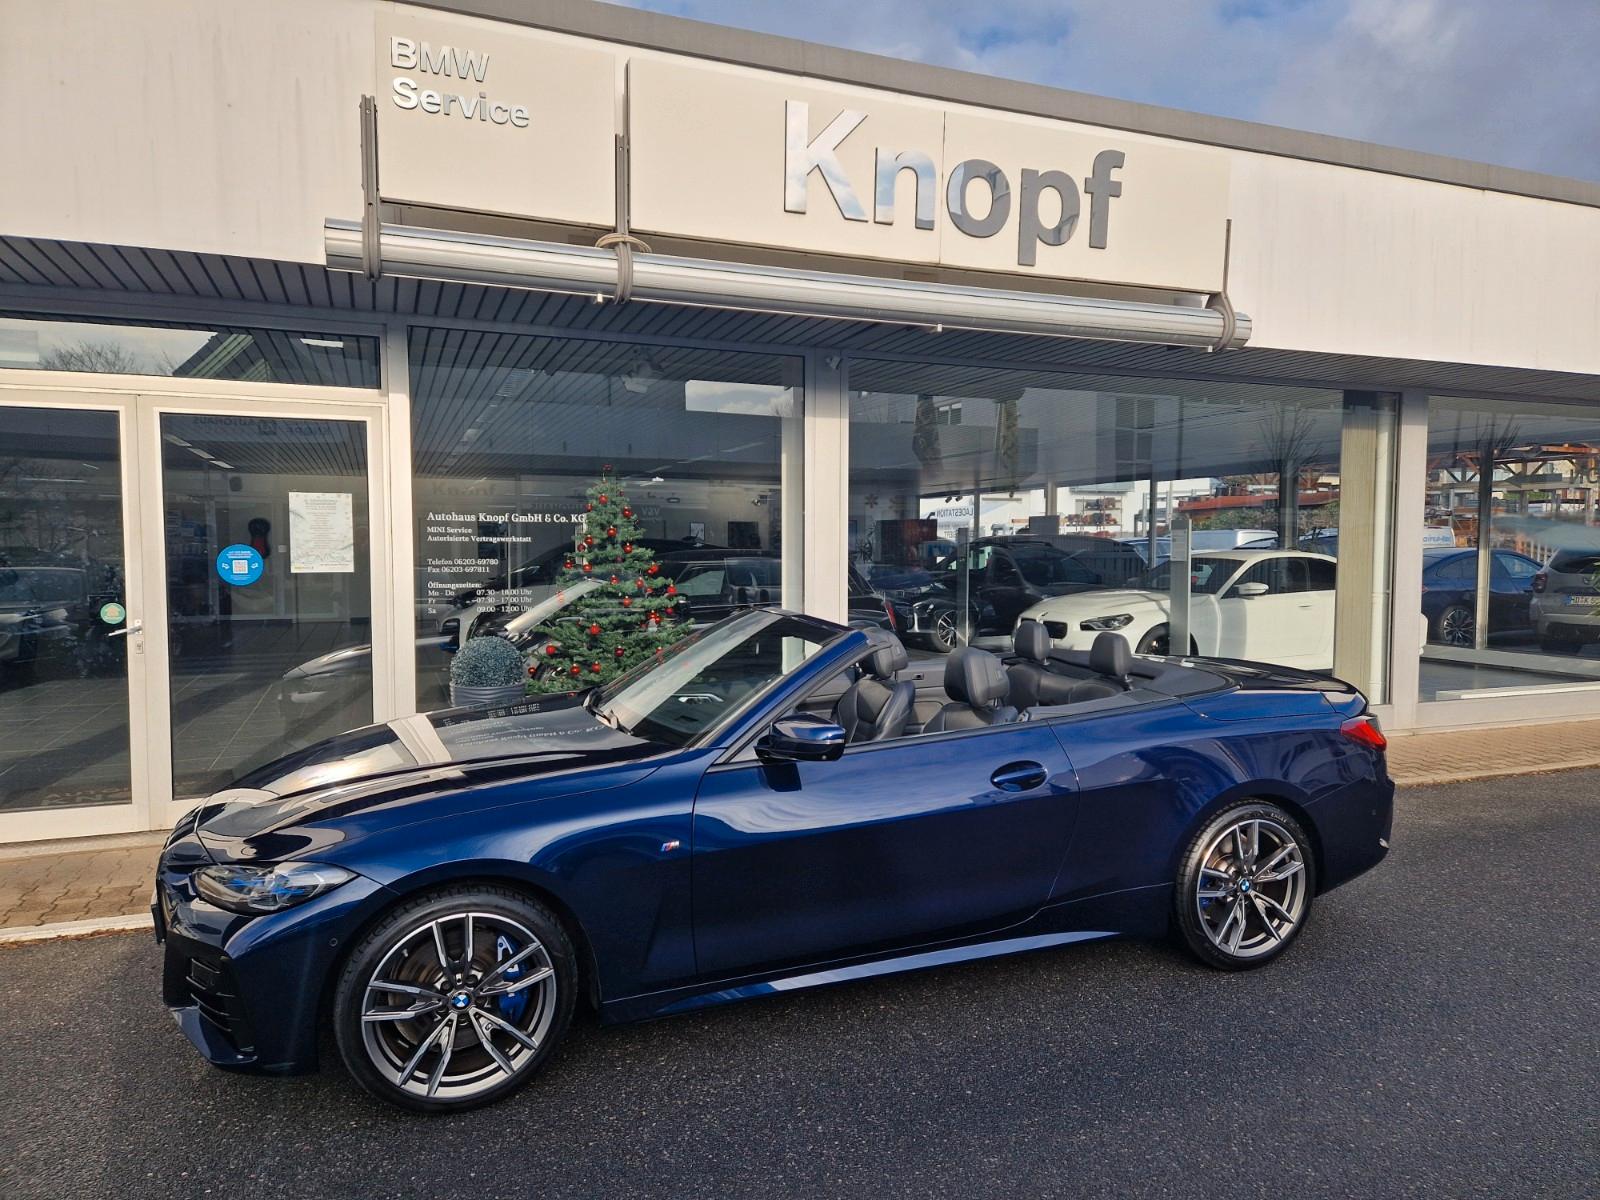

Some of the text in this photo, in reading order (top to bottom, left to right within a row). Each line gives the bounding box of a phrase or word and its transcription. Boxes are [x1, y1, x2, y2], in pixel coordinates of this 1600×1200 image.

[391, 36, 490, 83] BMW
[392, 77, 530, 128] Service
[784, 99, 1125, 266] Knopf
[426, 511, 476, 522] Autohaus
[478, 512, 510, 525] Knopf
[511, 513, 542, 523] GmbH
[544, 513, 551, 523] &
[553, 513, 569, 523] Co.
[427, 526, 473, 534] MINI Service
[470, 535, 532, 544] Vertragswerkstatt
[427, 558, 499, 566] Telefon 06203-69780
[427, 581, 482, 589] Öffnungszeiten:
[520, 596, 532, 604] Uhr
